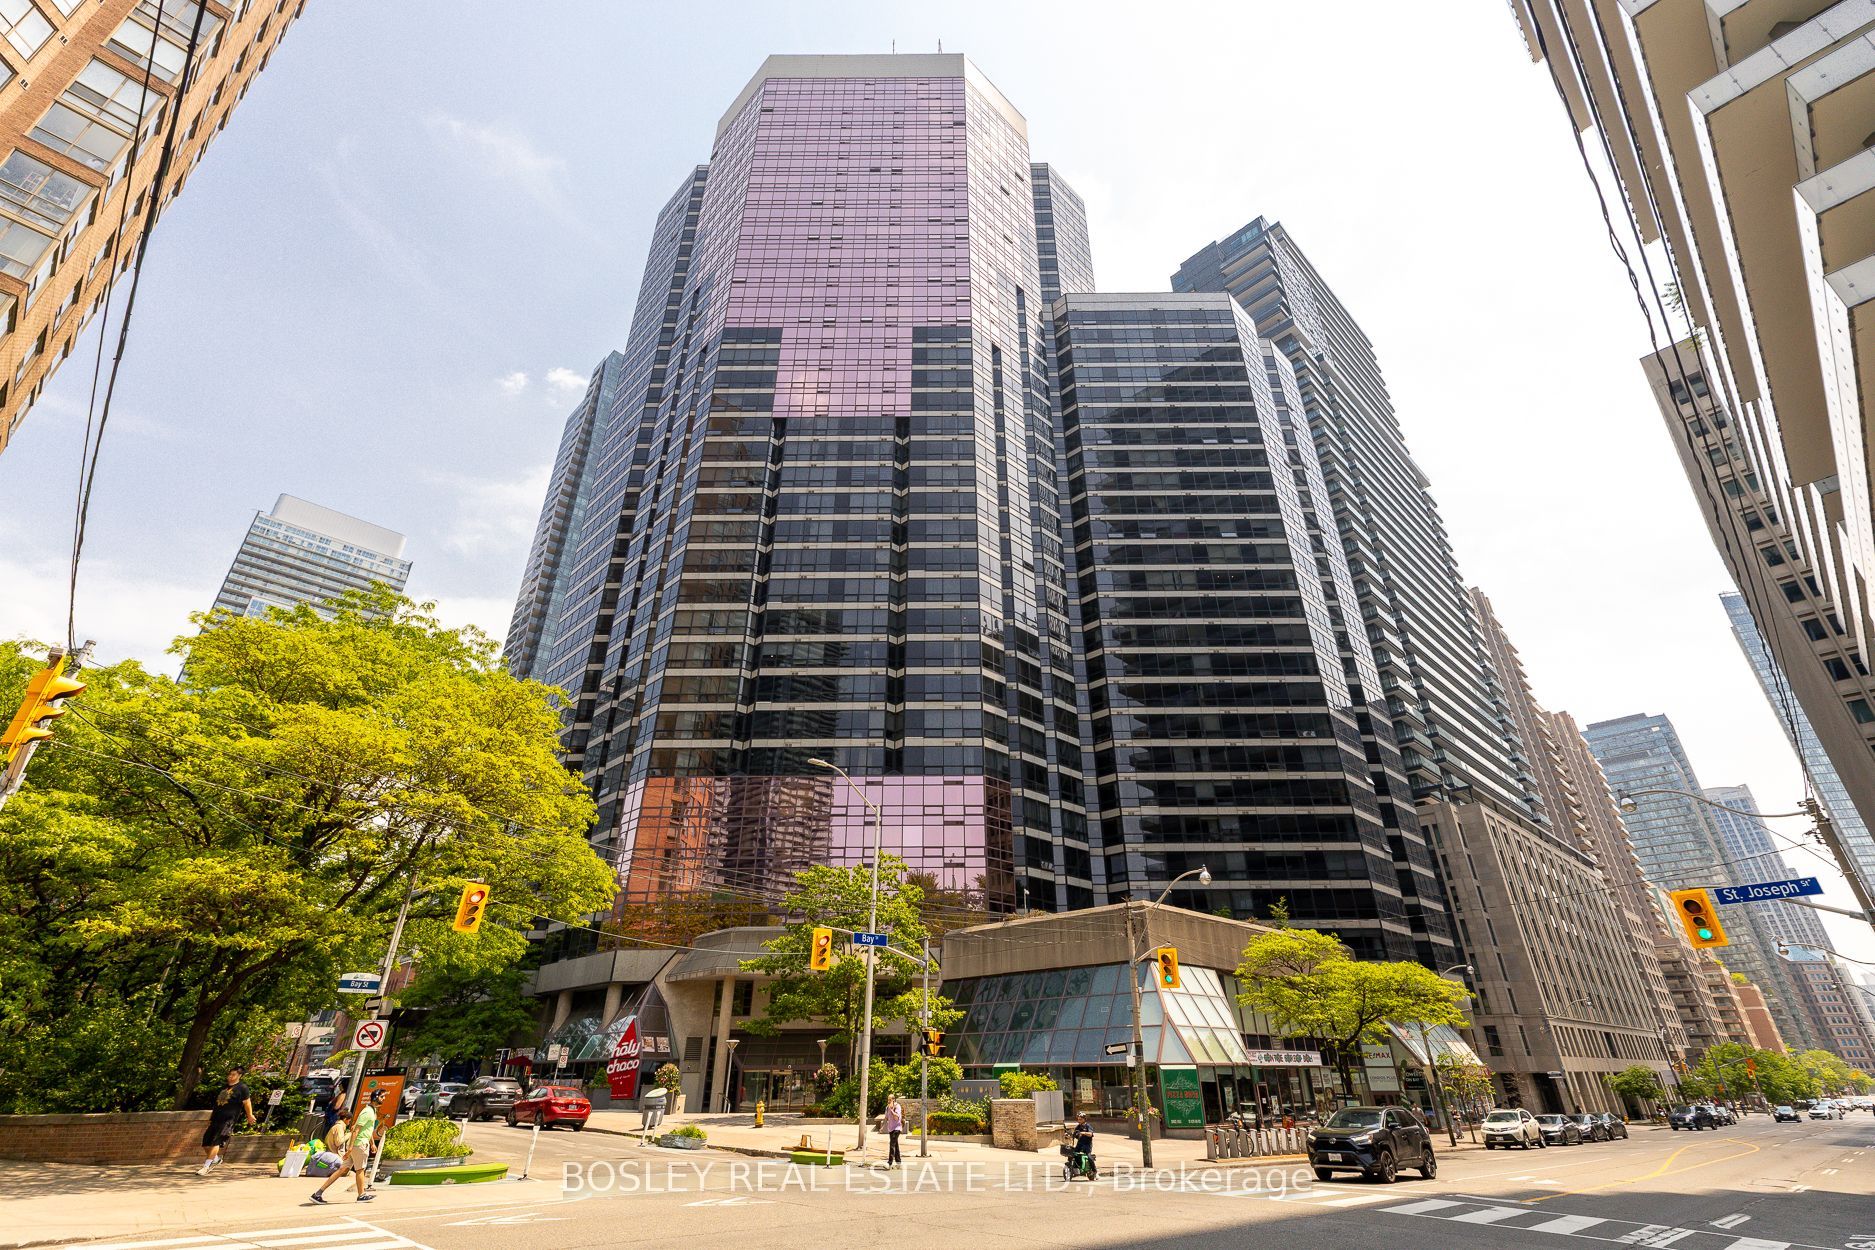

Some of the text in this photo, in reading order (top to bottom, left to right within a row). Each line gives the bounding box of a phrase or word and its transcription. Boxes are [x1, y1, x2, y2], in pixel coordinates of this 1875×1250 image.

[1723, 888, 1744, 901] St.
[1748, 881, 1800, 898] Joseph
[861, 934, 874, 944] Bay
[606, 1059, 640, 1074] choco
